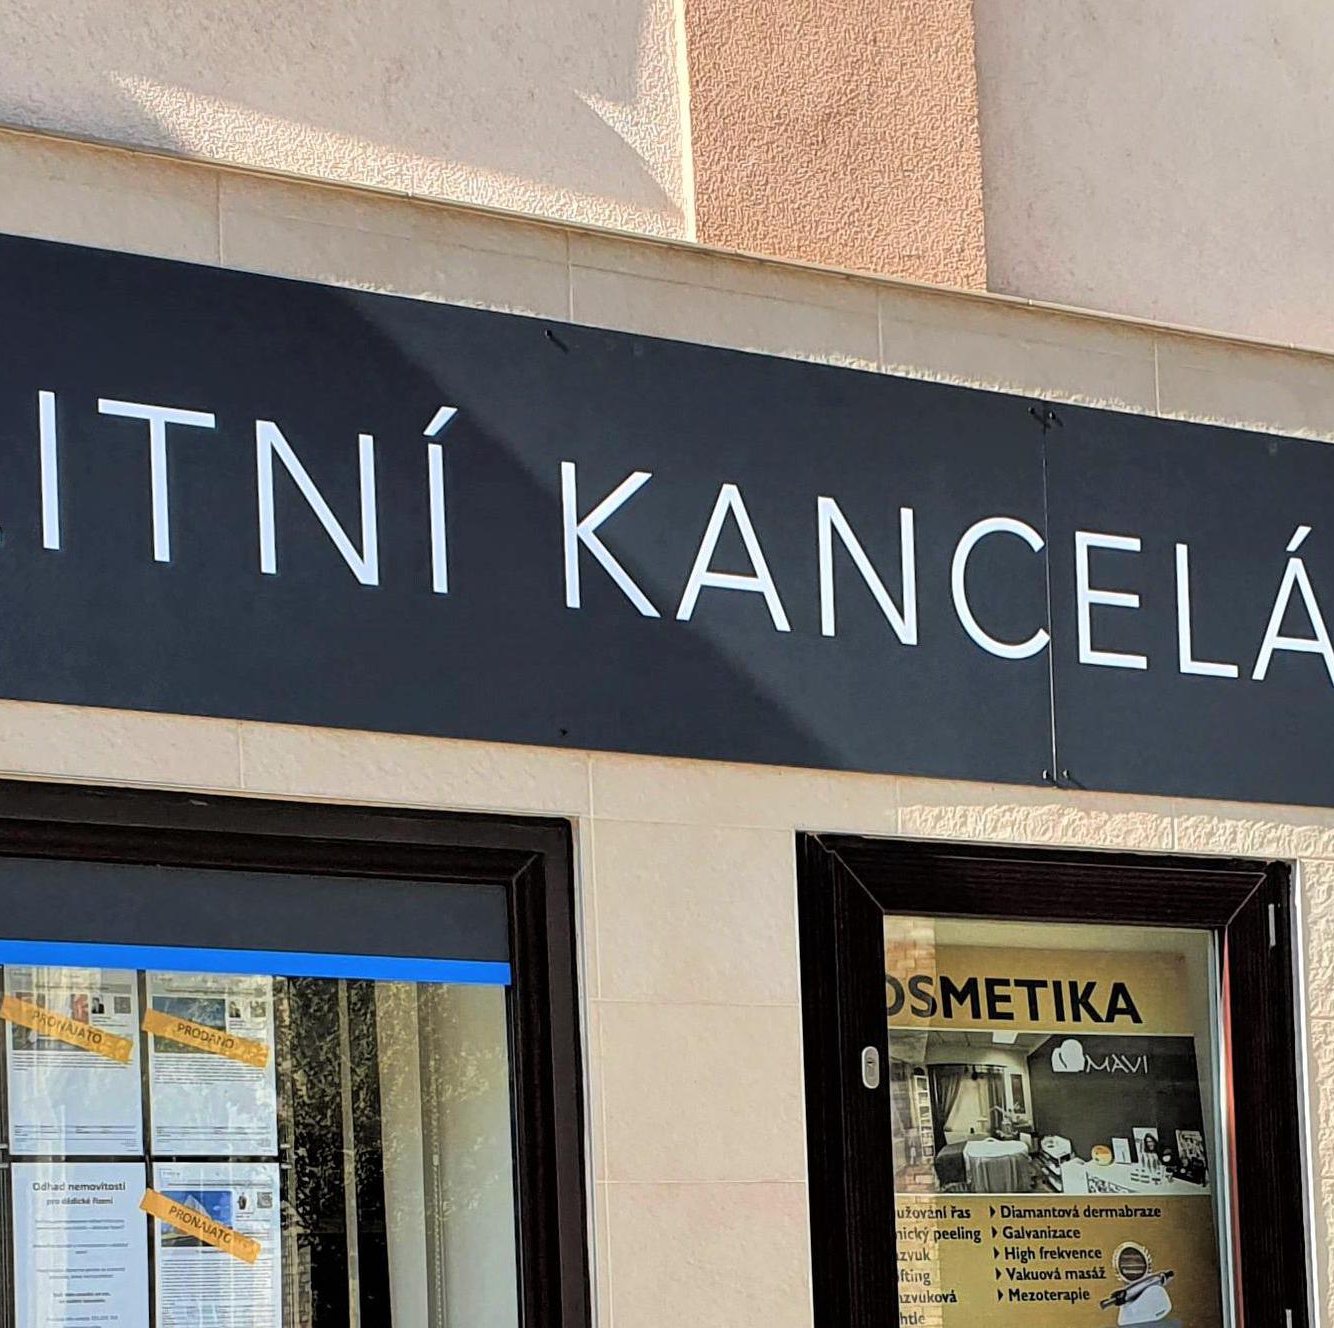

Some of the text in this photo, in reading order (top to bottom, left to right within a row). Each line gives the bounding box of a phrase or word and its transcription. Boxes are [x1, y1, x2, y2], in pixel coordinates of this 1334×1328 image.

[1085, 1053, 1148, 1074] MAVI
[951, 1205, 971, 1219] řas
[1000, 1205, 1162, 1219] Diamantová dermabraze
[168, 1205, 232, 1244] PRONAJATO
[933, 1226, 981, 1244] peeling
[1002, 1226, 1082, 1240] Galvanizace
[897, 1247, 931, 1262] zvuk
[1004, 1246, 1103, 1264] High frekvence
[1006, 1267, 1107, 1281] Vakuová masáž
[1008, 1288, 1091, 1304] Mezoterapie
